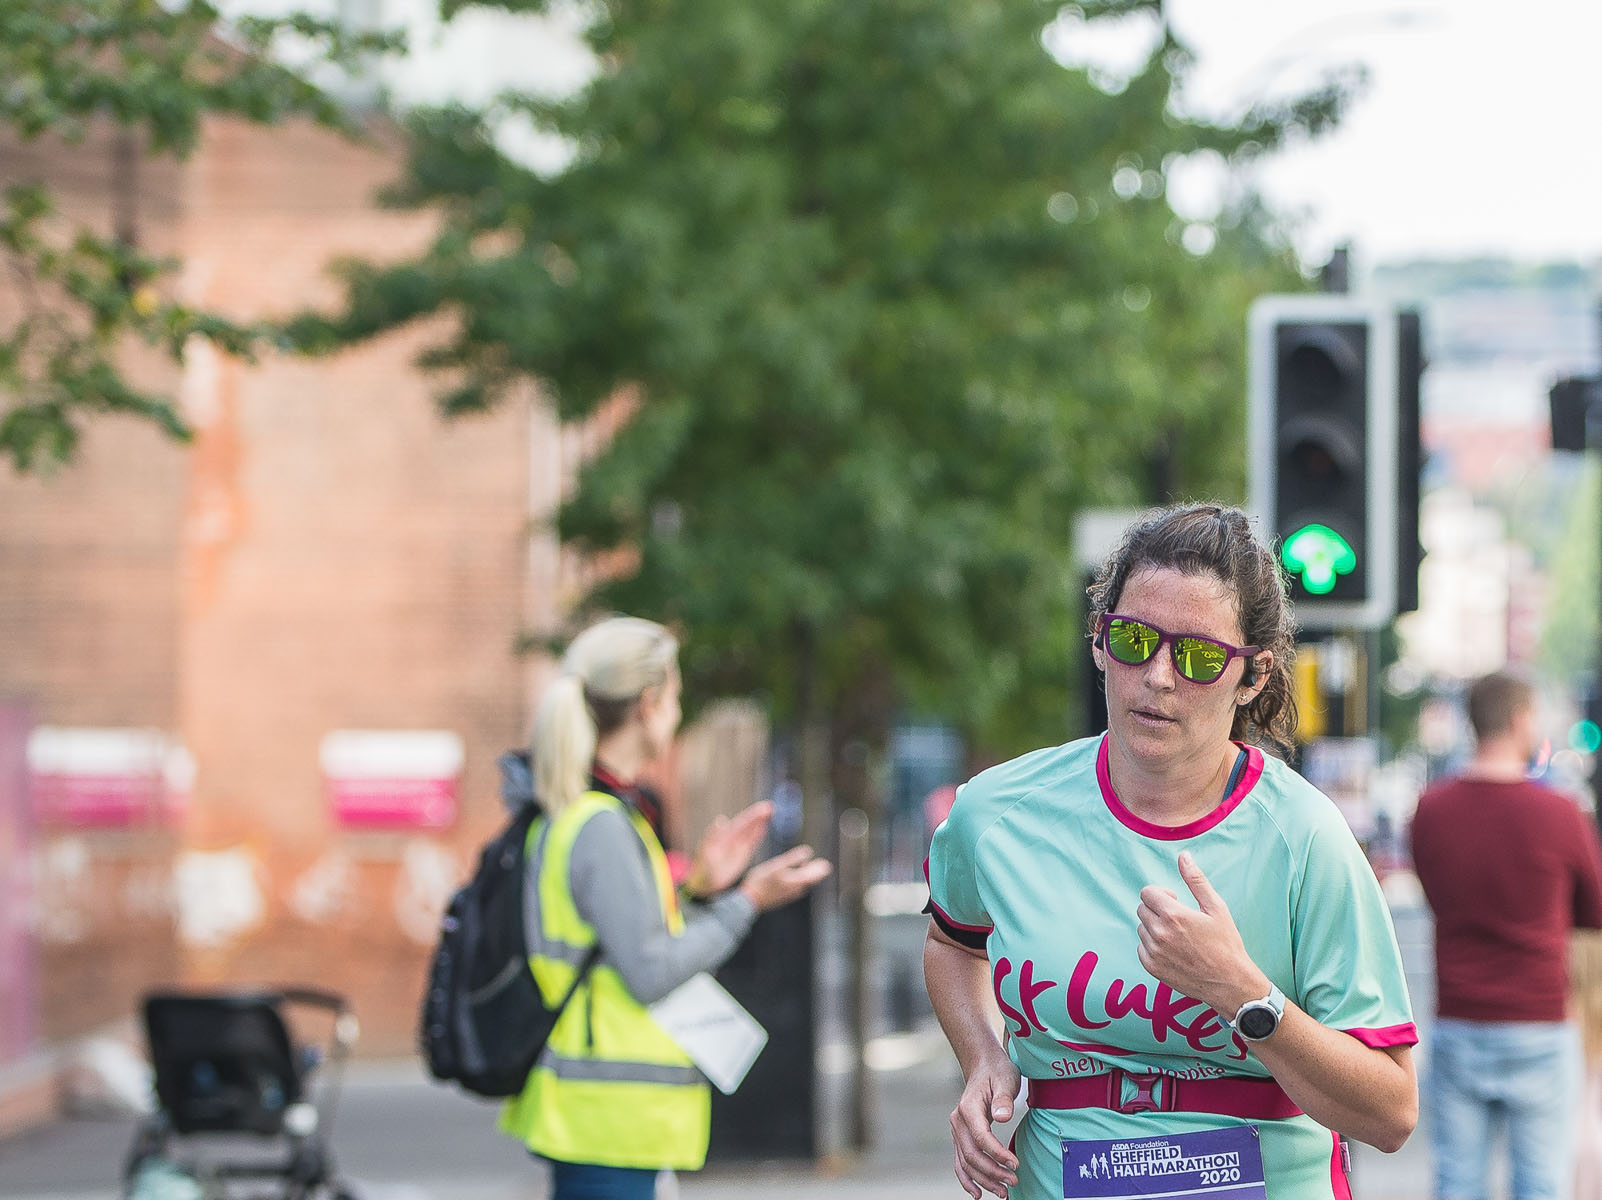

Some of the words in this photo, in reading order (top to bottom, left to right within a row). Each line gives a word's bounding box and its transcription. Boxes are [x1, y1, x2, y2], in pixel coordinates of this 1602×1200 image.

[994, 956, 1058, 1038] St
[1111, 1143, 1130, 1151] ASDA
[1130, 1140, 1169, 1150] Foundation
[1112, 1147, 1180, 1163] SHEFFIELD
[1113, 1163, 1150, 1178] HALF
[1151, 1152, 1238, 1175] MARATHON
[1200, 1167, 1241, 1185] 2020
